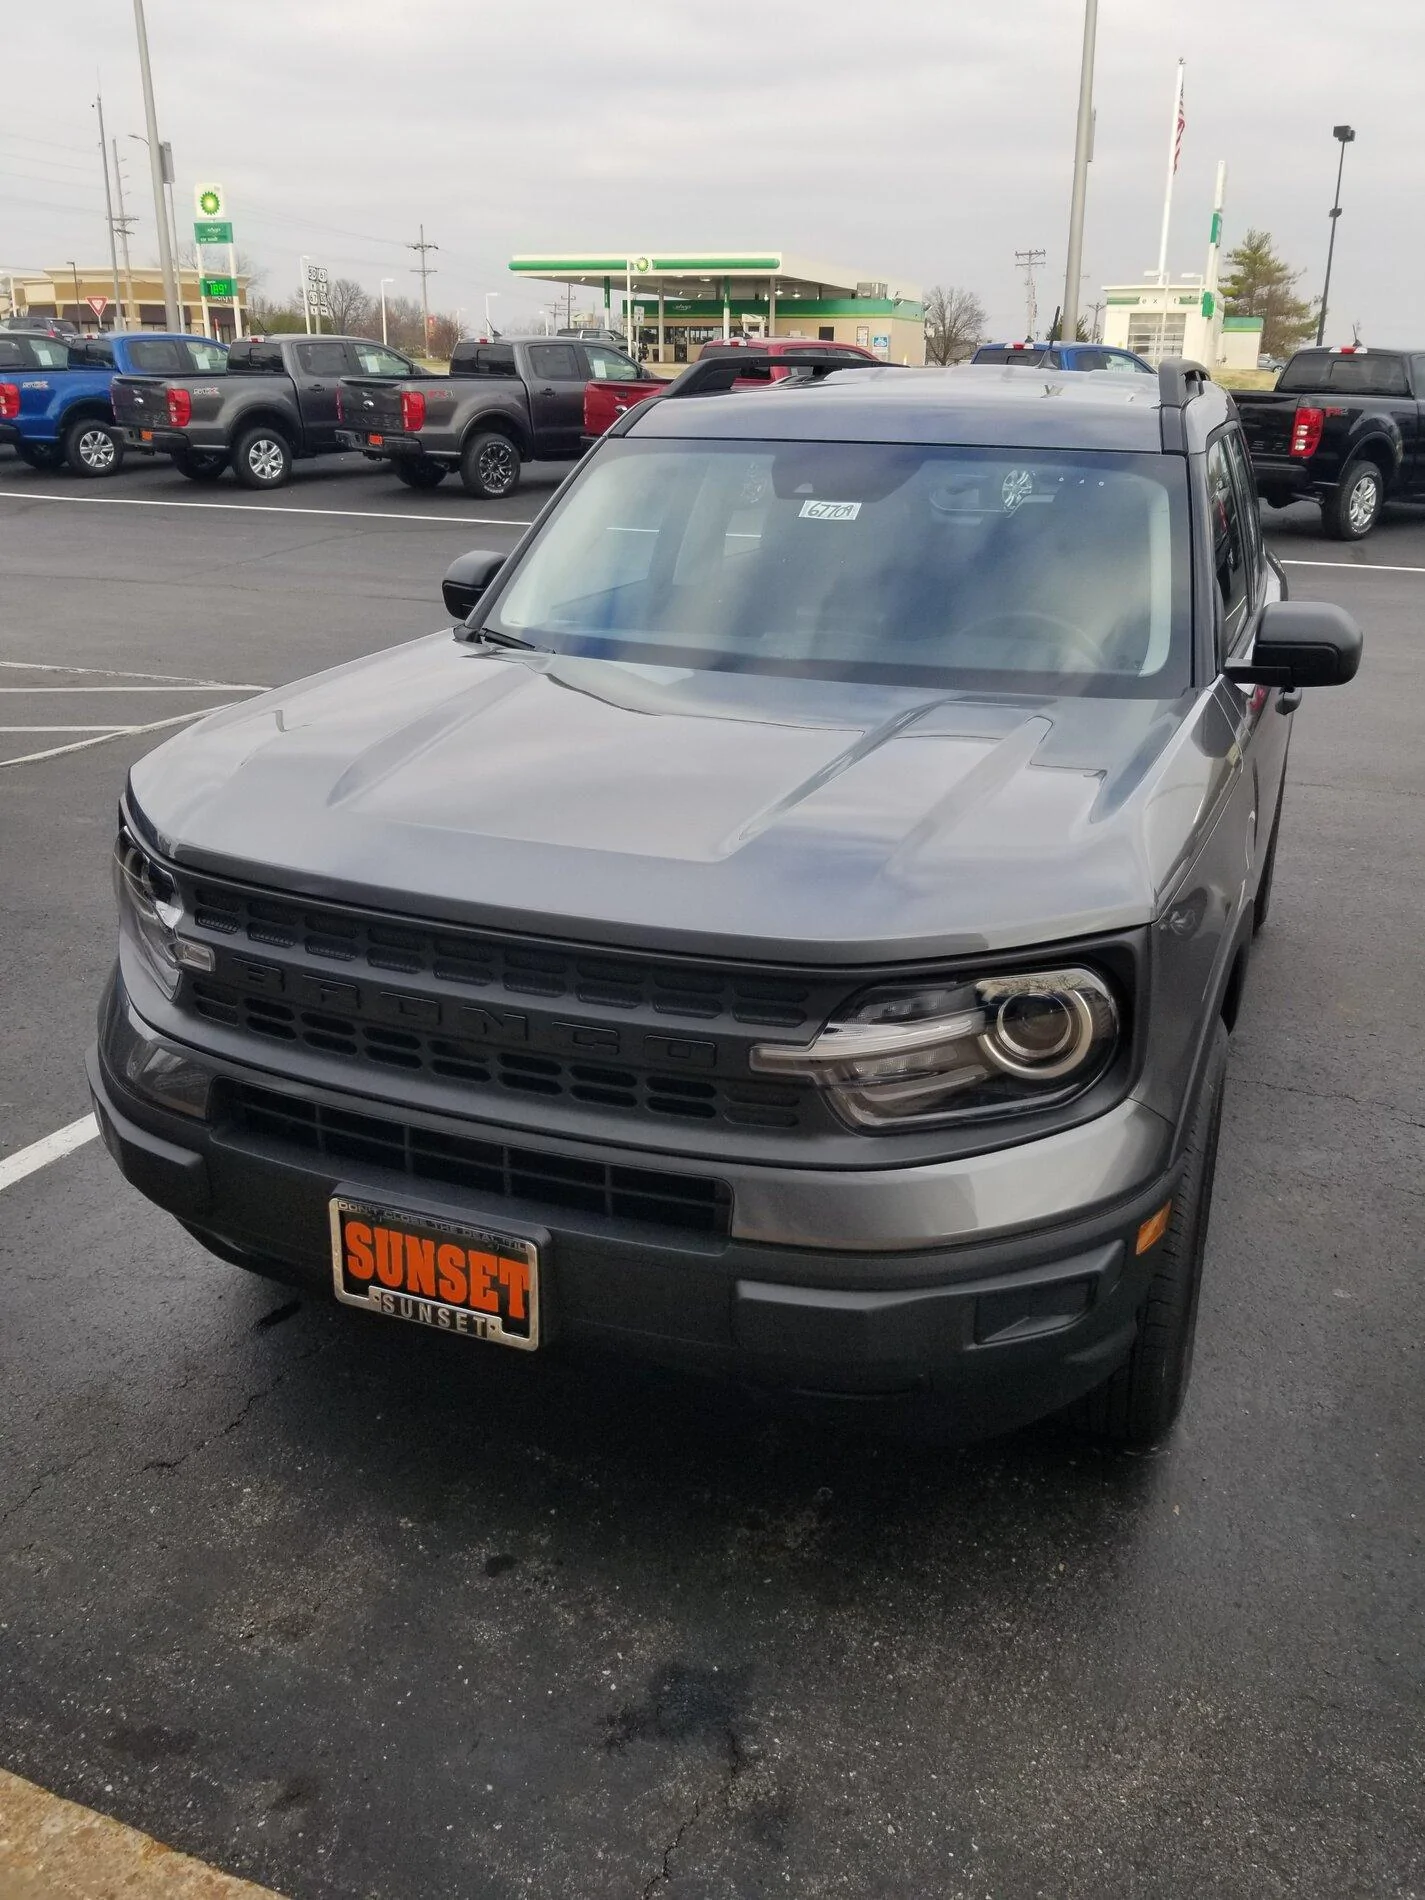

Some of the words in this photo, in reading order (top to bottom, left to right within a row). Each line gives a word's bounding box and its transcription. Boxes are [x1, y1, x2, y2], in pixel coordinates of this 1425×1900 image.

[231, 956, 718, 1068] BRONCO
[344, 1220, 531, 1320] SUNSET
[382, 1293, 487, 1337] SUNSET
